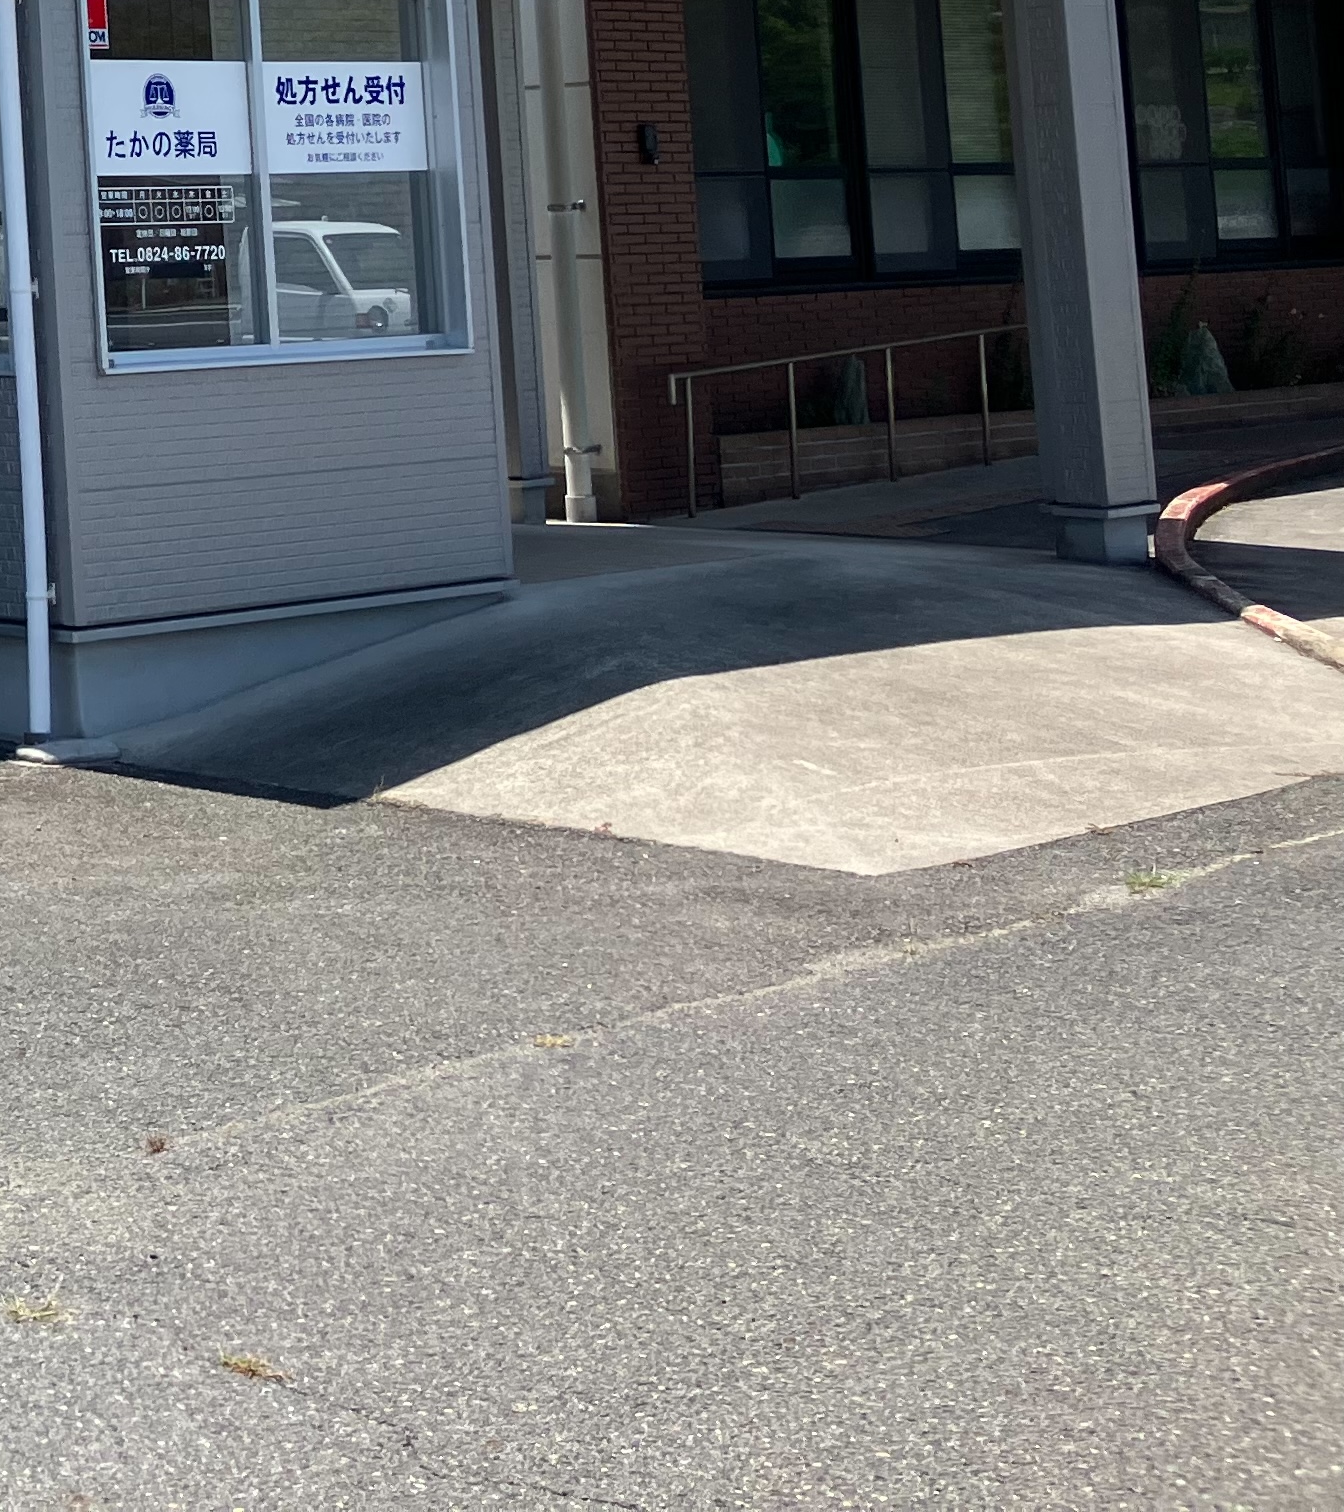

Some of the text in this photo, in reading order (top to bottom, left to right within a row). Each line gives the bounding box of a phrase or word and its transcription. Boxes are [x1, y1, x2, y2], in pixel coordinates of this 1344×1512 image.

[275, 75, 406, 105] 処方せん受付
[105, 130, 218, 159] たかの薬局
[285, 131, 401, 145] 処方せんを受付いたします
